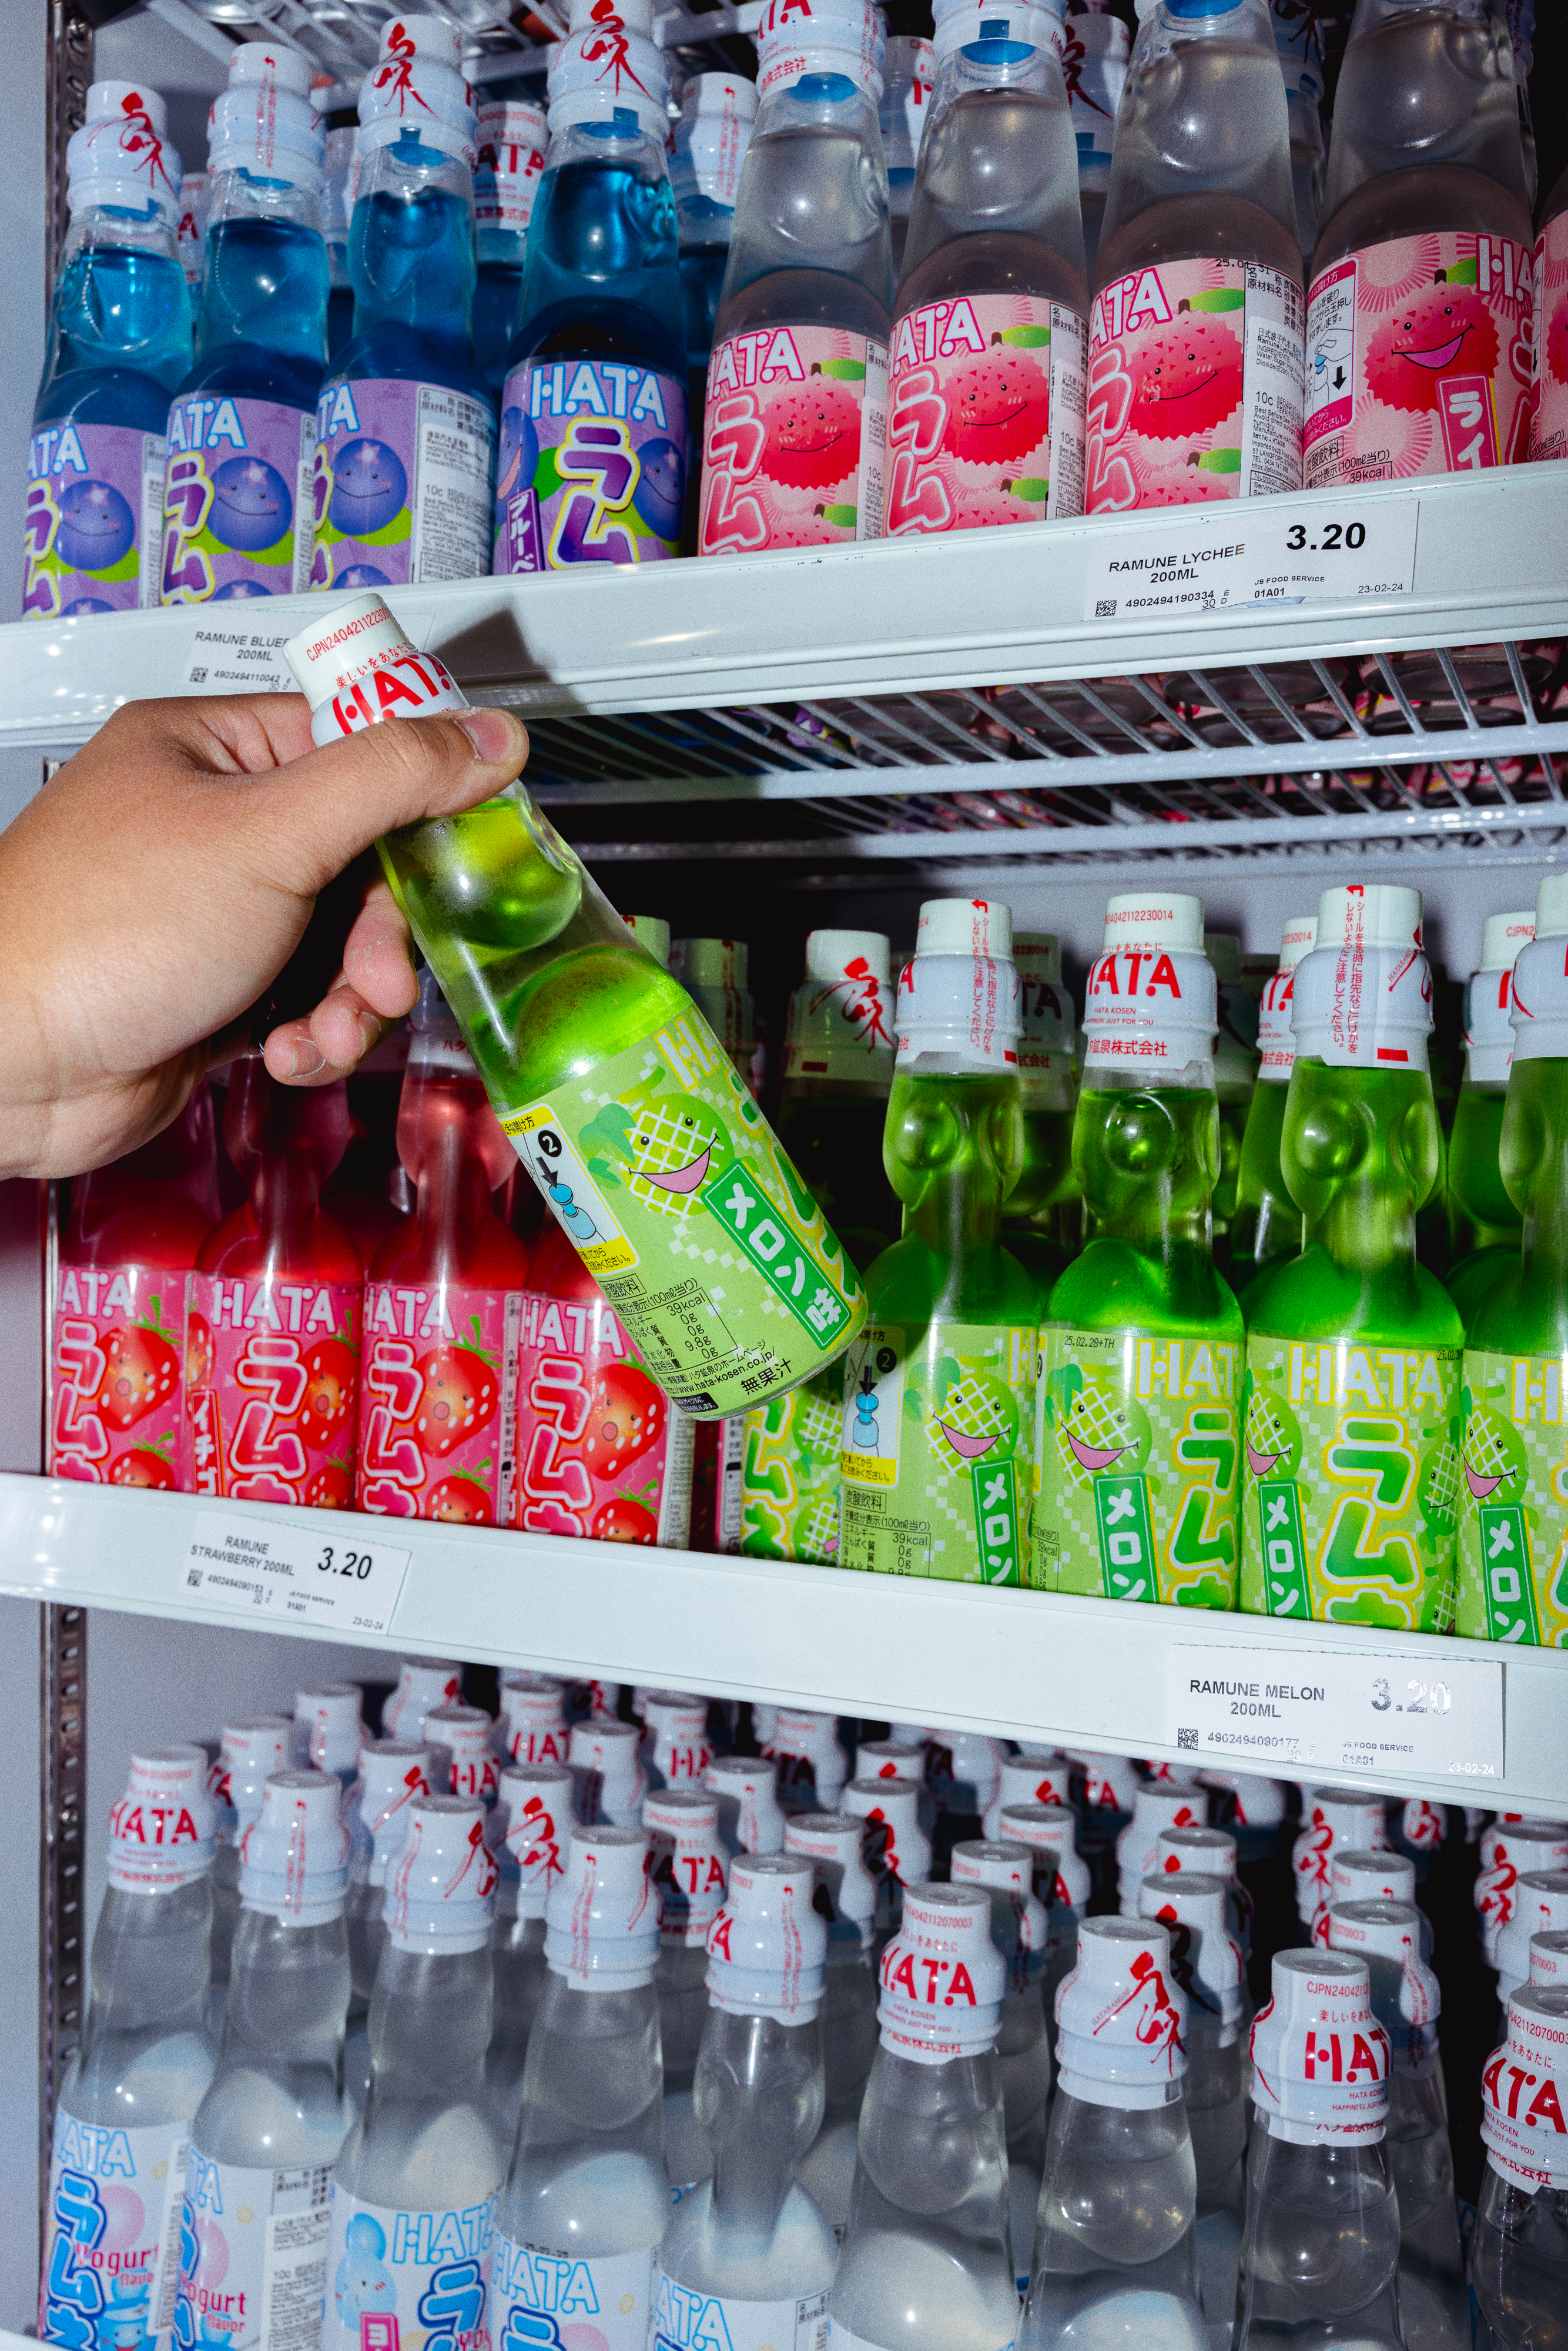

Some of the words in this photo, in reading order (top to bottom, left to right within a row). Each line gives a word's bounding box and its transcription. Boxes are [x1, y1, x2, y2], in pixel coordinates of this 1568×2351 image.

[1248, 279, 1282, 298] 原材料名
[1089, 267, 1173, 360] ATA
[889, 298, 986, 379] ATA
[530, 362, 669, 431] HATA
[1256, 391, 1274, 406] 10c
[1349, 465, 1385, 483] 39kcal
[1285, 522, 1367, 551] 3.20
[1108, 555, 1178, 574] RAMUNE
[1182, 543, 1246, 566] LYCHEE
[1150, 568, 1200, 584] 200ML
[1266, 575, 1289, 584] FOOD
[1254, 587, 1286, 598] 01A01
[1357, 582, 1404, 594] 23-02-24
[1125, 590, 1215, 608] 4902494190334
[1201, 598, 1216, 609] 30
[195, 631, 248, 645] RAMUNE
[236, 649, 273, 661] 200ML
[1021, 982, 1063, 1020] TA
[541, 1134, 558, 1154] 2
[724, 1182, 843, 1332] メロン味
[212, 1280, 337, 1334] HATA
[666, 1292, 706, 1317] 39kcal
[680, 1312, 698, 1325] 0g
[687, 1324, 705, 1337] 0g
[684, 1335, 712, 1352] 9.8g
[1064, 1334, 1115, 1349] 25.02.28+TH
[701, 1347, 719, 1359] 0g
[741, 1358, 792, 1395] 無果汁
[1288, 1342, 1446, 1412] HATA
[982, 1472, 1015, 1585] メロン
[225, 1535, 270, 1556] RAMUNE
[893, 1532, 928, 1546] 39kcal
[899, 1545, 913, 1558] 0g
[1266, 1495, 1300, 1616] メロン
[263, 1559, 294, 1576] 200ML
[317, 1546, 373, 1580] 3.20
[897, 1557, 912, 1569] 0g
[1190, 1679, 1260, 1698] RAMUNE
[1265, 1684, 1325, 1702] MELON
[1371, 1677, 1452, 1716] 3.20
[1230, 1702, 1281, 1719] 200ML
[1354, 1742, 1377, 1750] FOOD
[1379, 1743, 1414, 1752] SERVICE
[1448, 1761, 1495, 1775] 23-02-24
[1304, 2027, 1393, 2083] HAT
[1349, 2090, 1368, 2100] HATA
[1481, 2049, 1567, 2135] ATA
[1332, 2103, 1366, 2111] HAPPINESS
[1496, 2118, 1519, 2138] KOSEN
[1493, 2128, 1505, 2141] JUST
[1506, 2136, 1519, 2150] FOR
[1520, 2145, 1535, 2156] YOU
